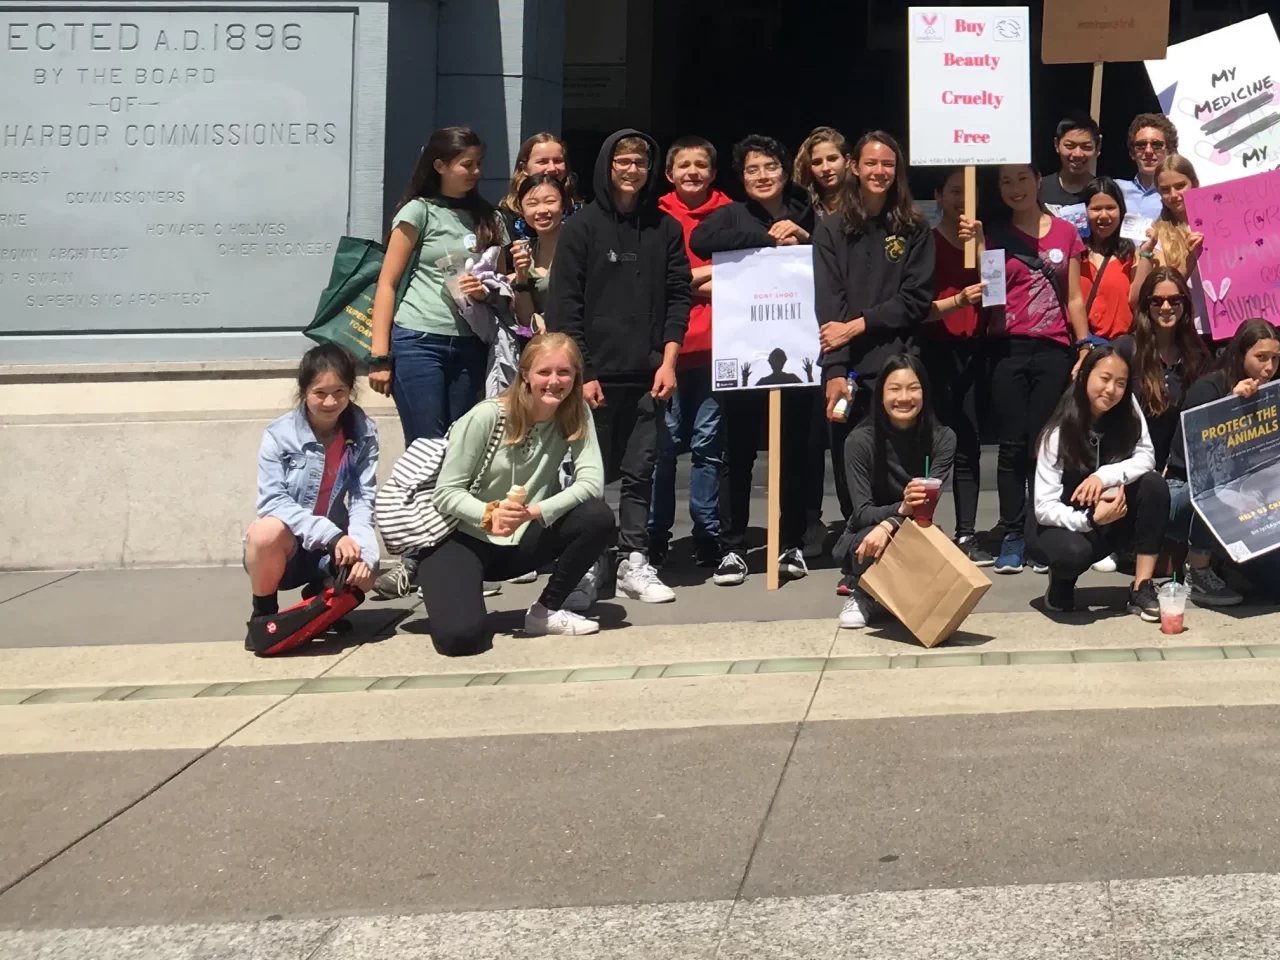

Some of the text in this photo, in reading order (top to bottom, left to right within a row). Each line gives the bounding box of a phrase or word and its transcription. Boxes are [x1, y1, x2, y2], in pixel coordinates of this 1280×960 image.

[954, 18, 986, 36] Buy
[8, 23, 140, 51] ECTED
[214, 23, 303, 51] 1896
[943, 52, 1000, 71] Beauty
[34, 68, 216, 85] BY THE BOARD
[1211, 66, 1236, 88] MY
[109, 96, 138, 113] OF
[941, 90, 1004, 109] Cruelty
[1194, 75, 1274, 119] MEDICINE
[4, 123, 337, 147] HARBOR COMMISSIONERS
[953, 129, 991, 144] Free
[1242, 145, 1268, 168] MY
[66, 191, 186, 205] COMMISSIONERS
[147, 223, 206, 238] HOWARD
[228, 223, 287, 237] HOLMES
[1212, 218, 1231, 238] IS
[49, 247, 129, 261] ARCHITECT
[218, 242, 333, 257] CHIEF ENGINEER
[26, 292, 211, 308] SUPERVISING ARCHITECT
[750, 302, 801, 322] MOVEMENT
[1201, 405, 1278, 441] PROTECT THE
[1226, 419, 1279, 448] ANIMALS
[1238, 509, 1255, 522] HELP
[1257, 507, 1268, 515] US
